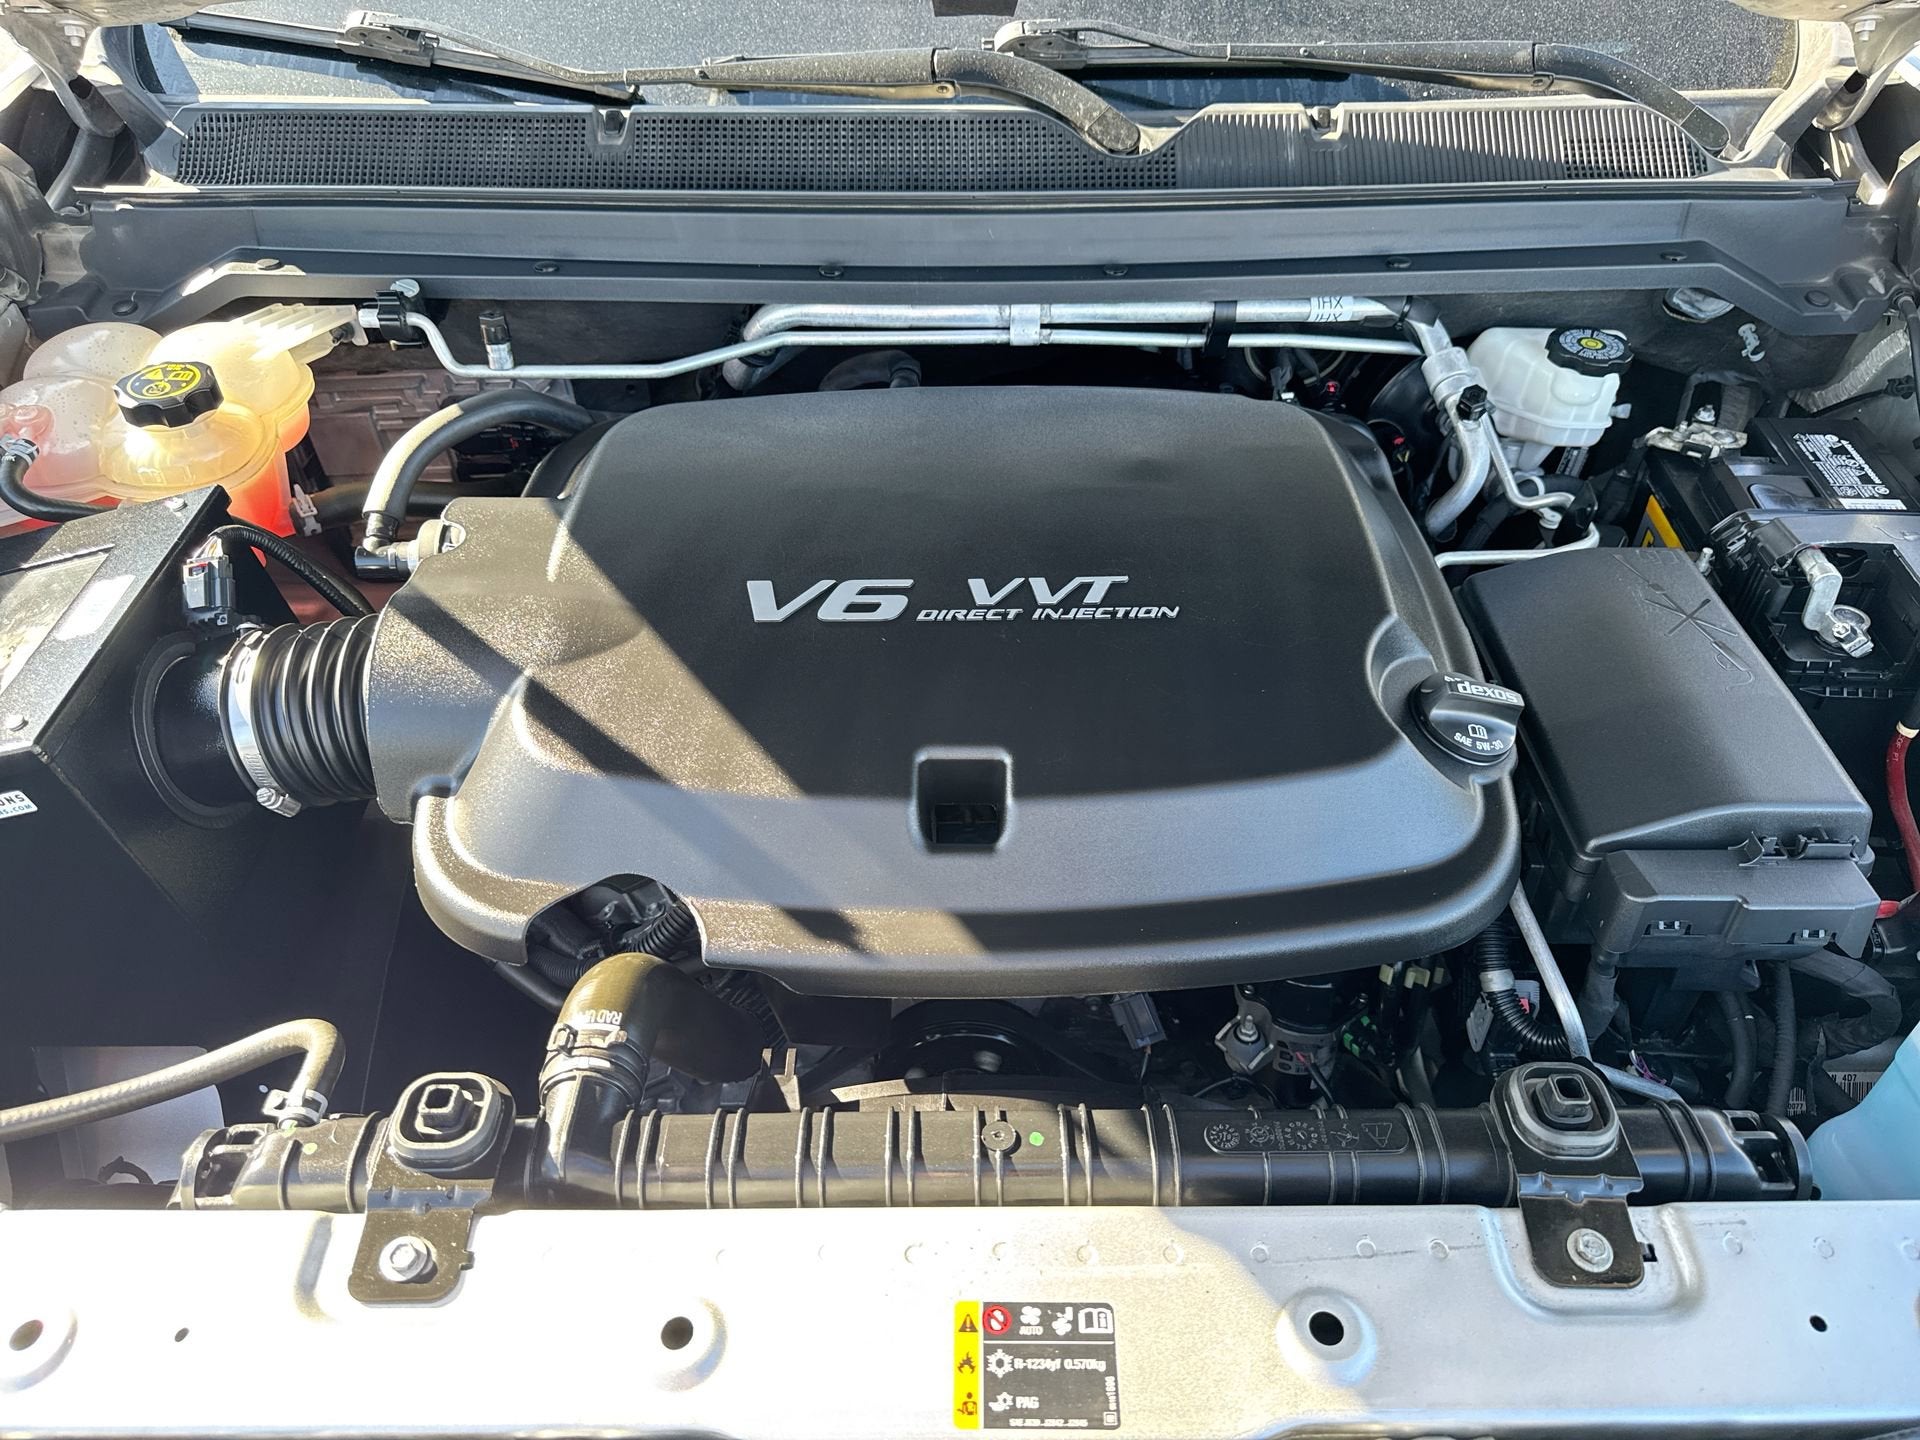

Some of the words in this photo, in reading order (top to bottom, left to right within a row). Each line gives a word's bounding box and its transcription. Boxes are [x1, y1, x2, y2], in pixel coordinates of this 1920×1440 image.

[746, 578, 914, 622] V6
[967, 575, 1129, 606] VVT
[915, 606, 1024, 622] DIRECT
[1032, 605, 1180, 621] INJECTION
[1457, 681, 1518, 703] dexos
[1453, 732, 1473, 747] SAE
[597, 1009, 623, 1024] RAD
